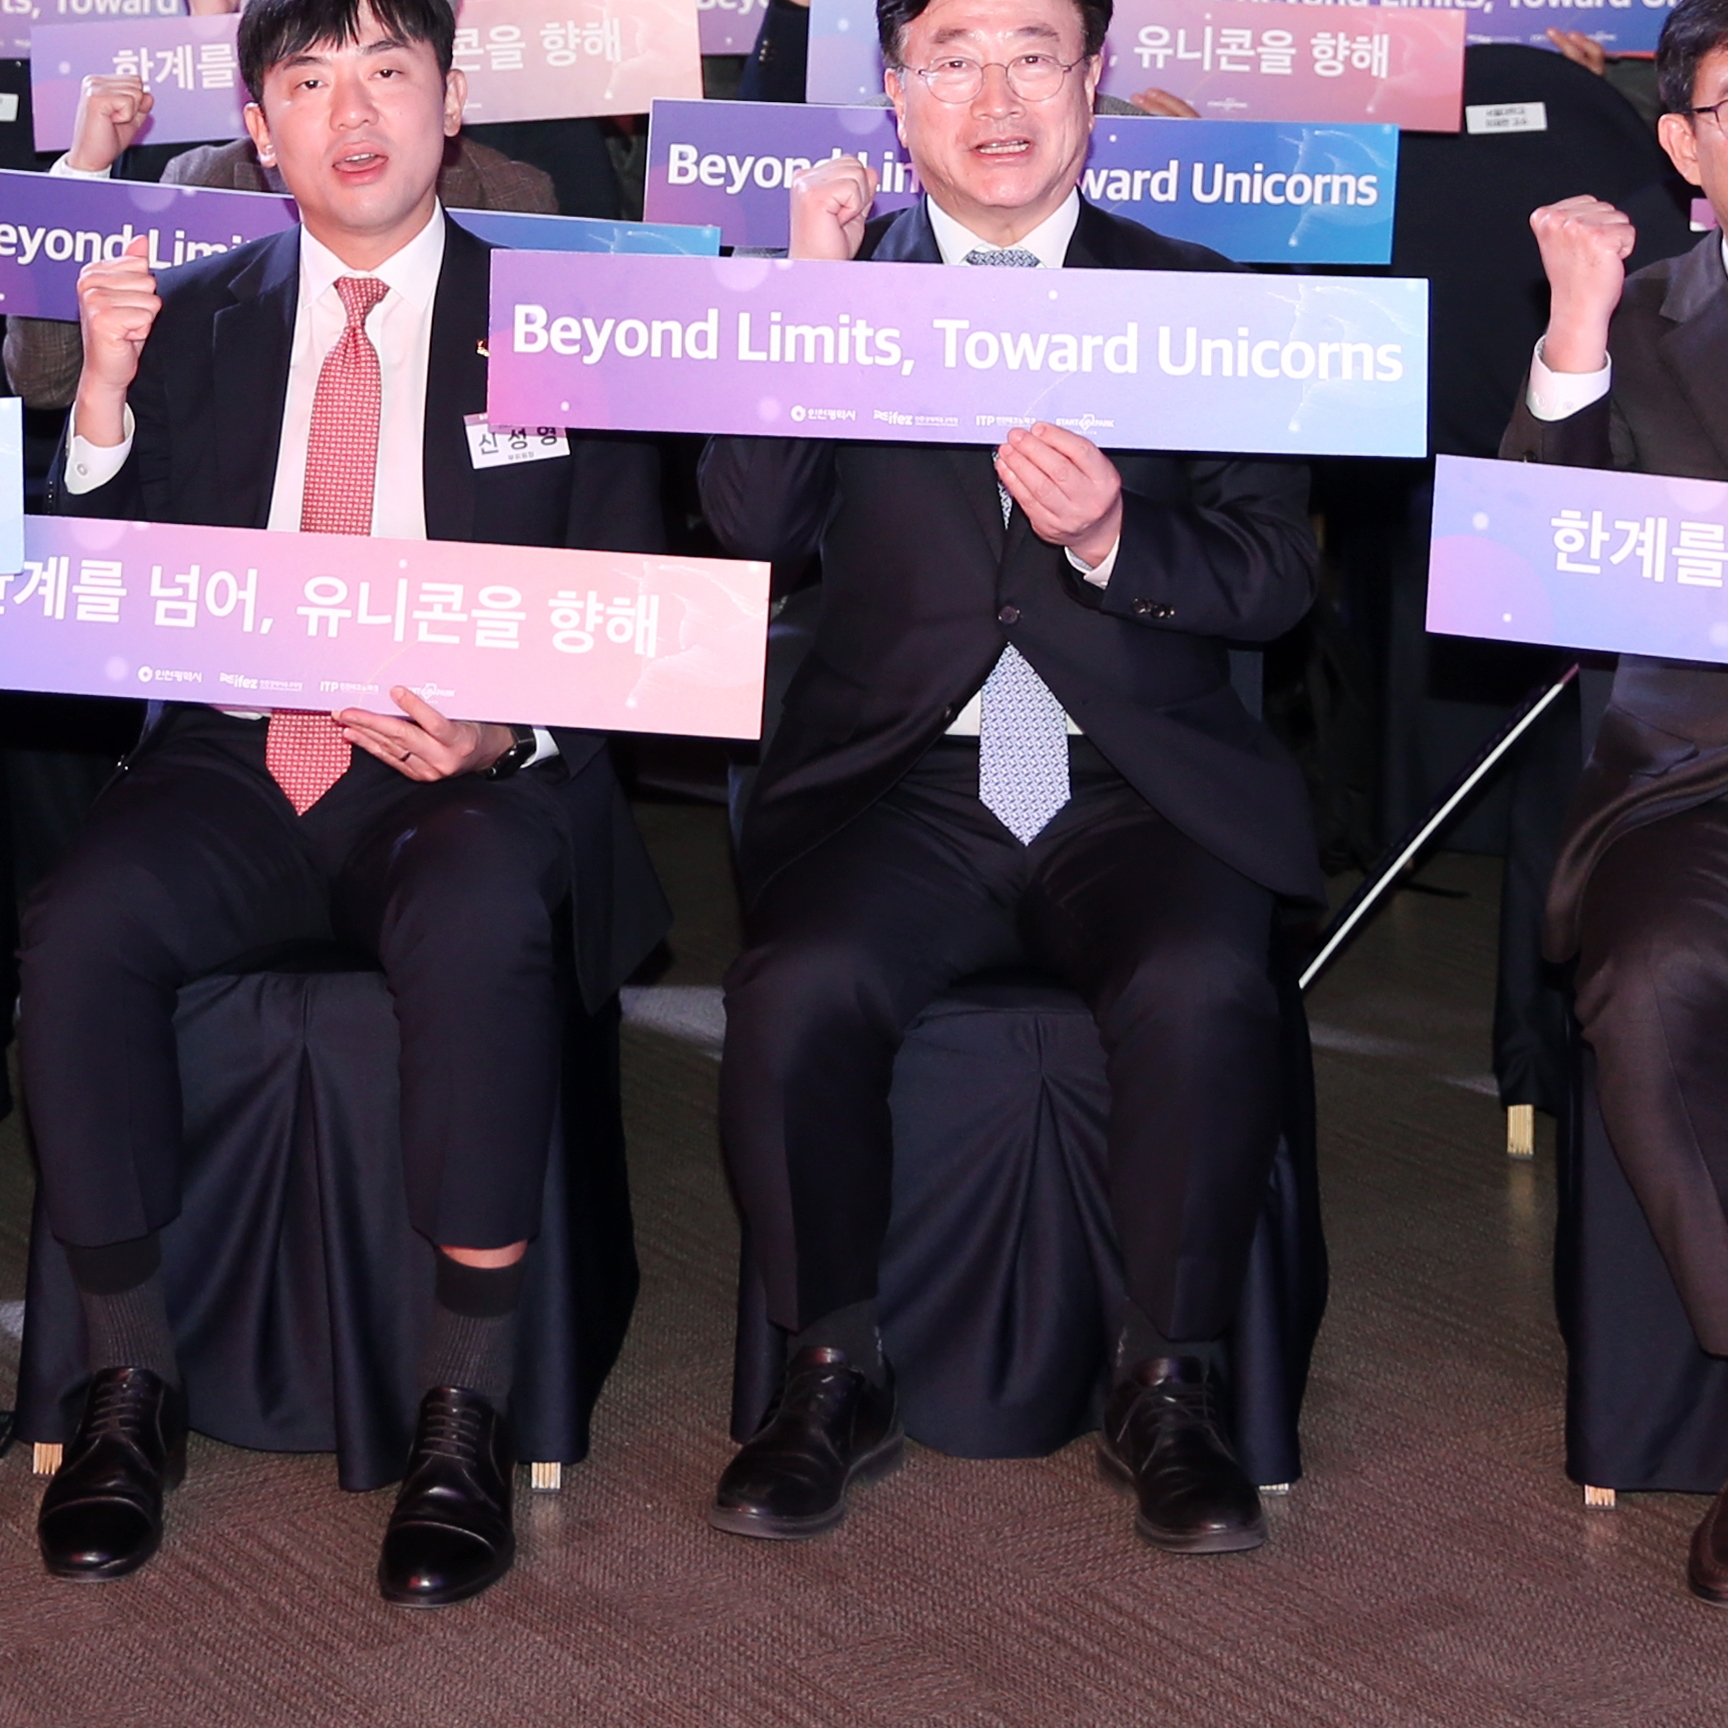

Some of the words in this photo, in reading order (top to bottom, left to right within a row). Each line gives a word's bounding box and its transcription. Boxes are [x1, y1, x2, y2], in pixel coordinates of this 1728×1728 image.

[539, 18, 624, 68] 향해
[1133, 16, 1297, 73] 유니콘을
[1310, 31, 1391, 79] 향해
[1079, 160, 1180, 203] ward
[1192, 164, 1379, 207] Unicorns
[512, 303, 720, 367] Beyond
[737, 310, 917, 378] Limits,
[932, 317, 1140, 376] Toward
[1158, 325, 1405, 385] Unicorns
[975, 414, 996, 427] ITP
[149, 563, 275, 634] 넘어,
[294, 570, 527, 652] 유니콘을
[547, 587, 660, 660] 향해
